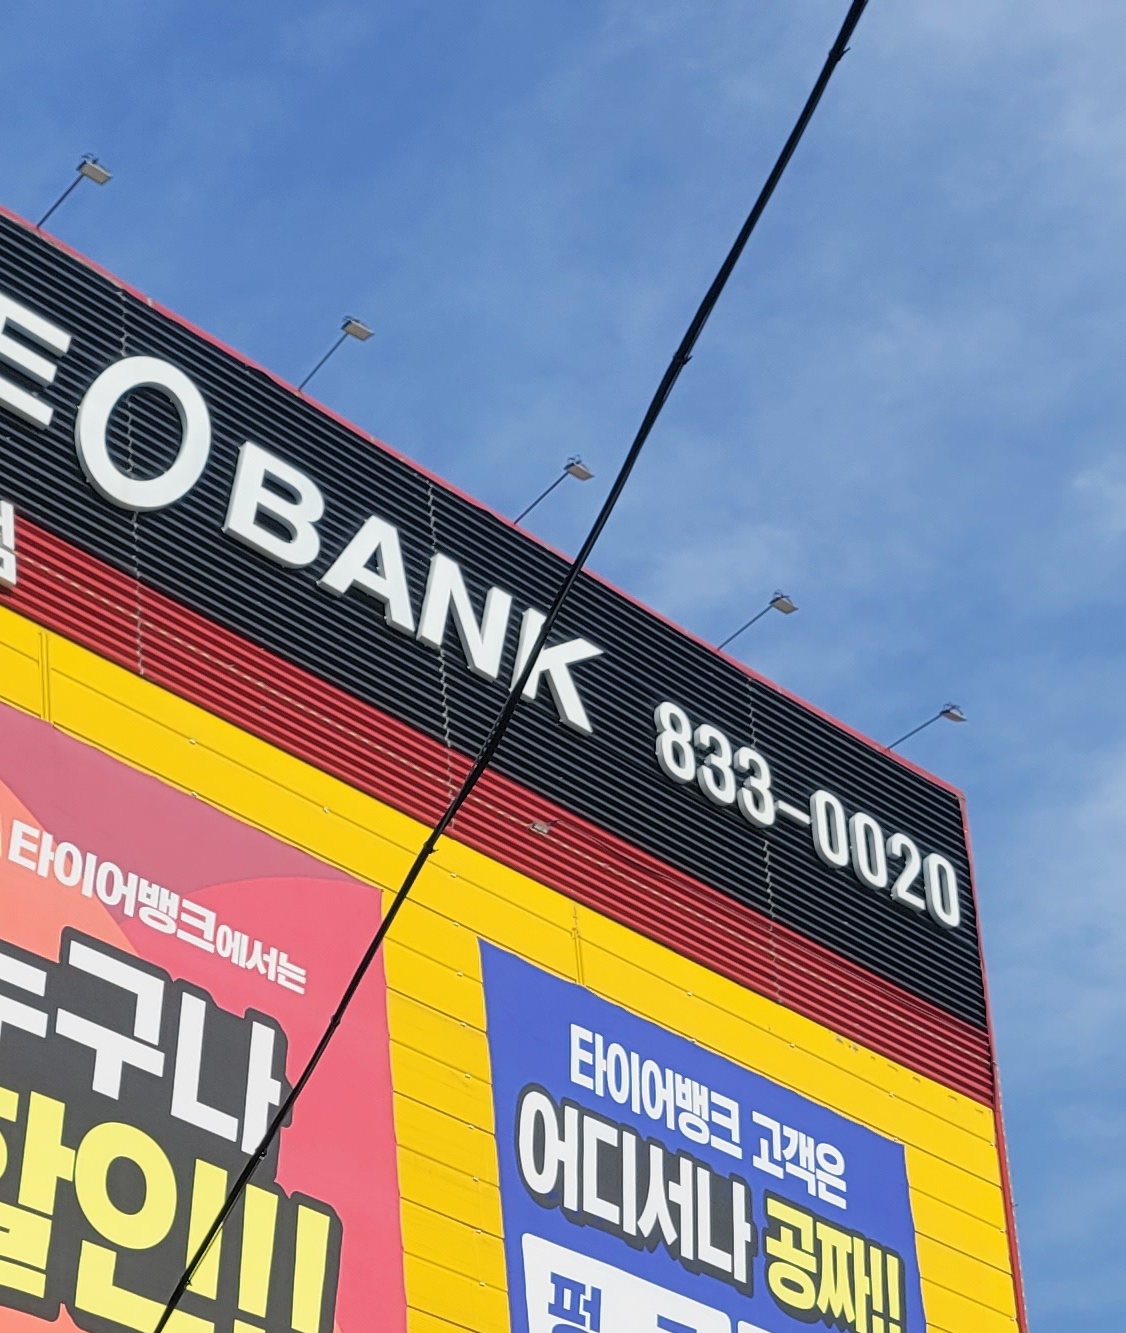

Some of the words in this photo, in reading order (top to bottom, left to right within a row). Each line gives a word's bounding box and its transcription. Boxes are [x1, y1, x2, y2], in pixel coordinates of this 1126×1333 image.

[7, 818, 307, 995] 타이어뱅크에서는
[654, 702, 961, 930] 833-0020
[519, 1093, 753, 1285] 어디서나
[569, 1022, 744, 1160] 타이어뱅크
[752, 1110, 848, 1210] 고객은
